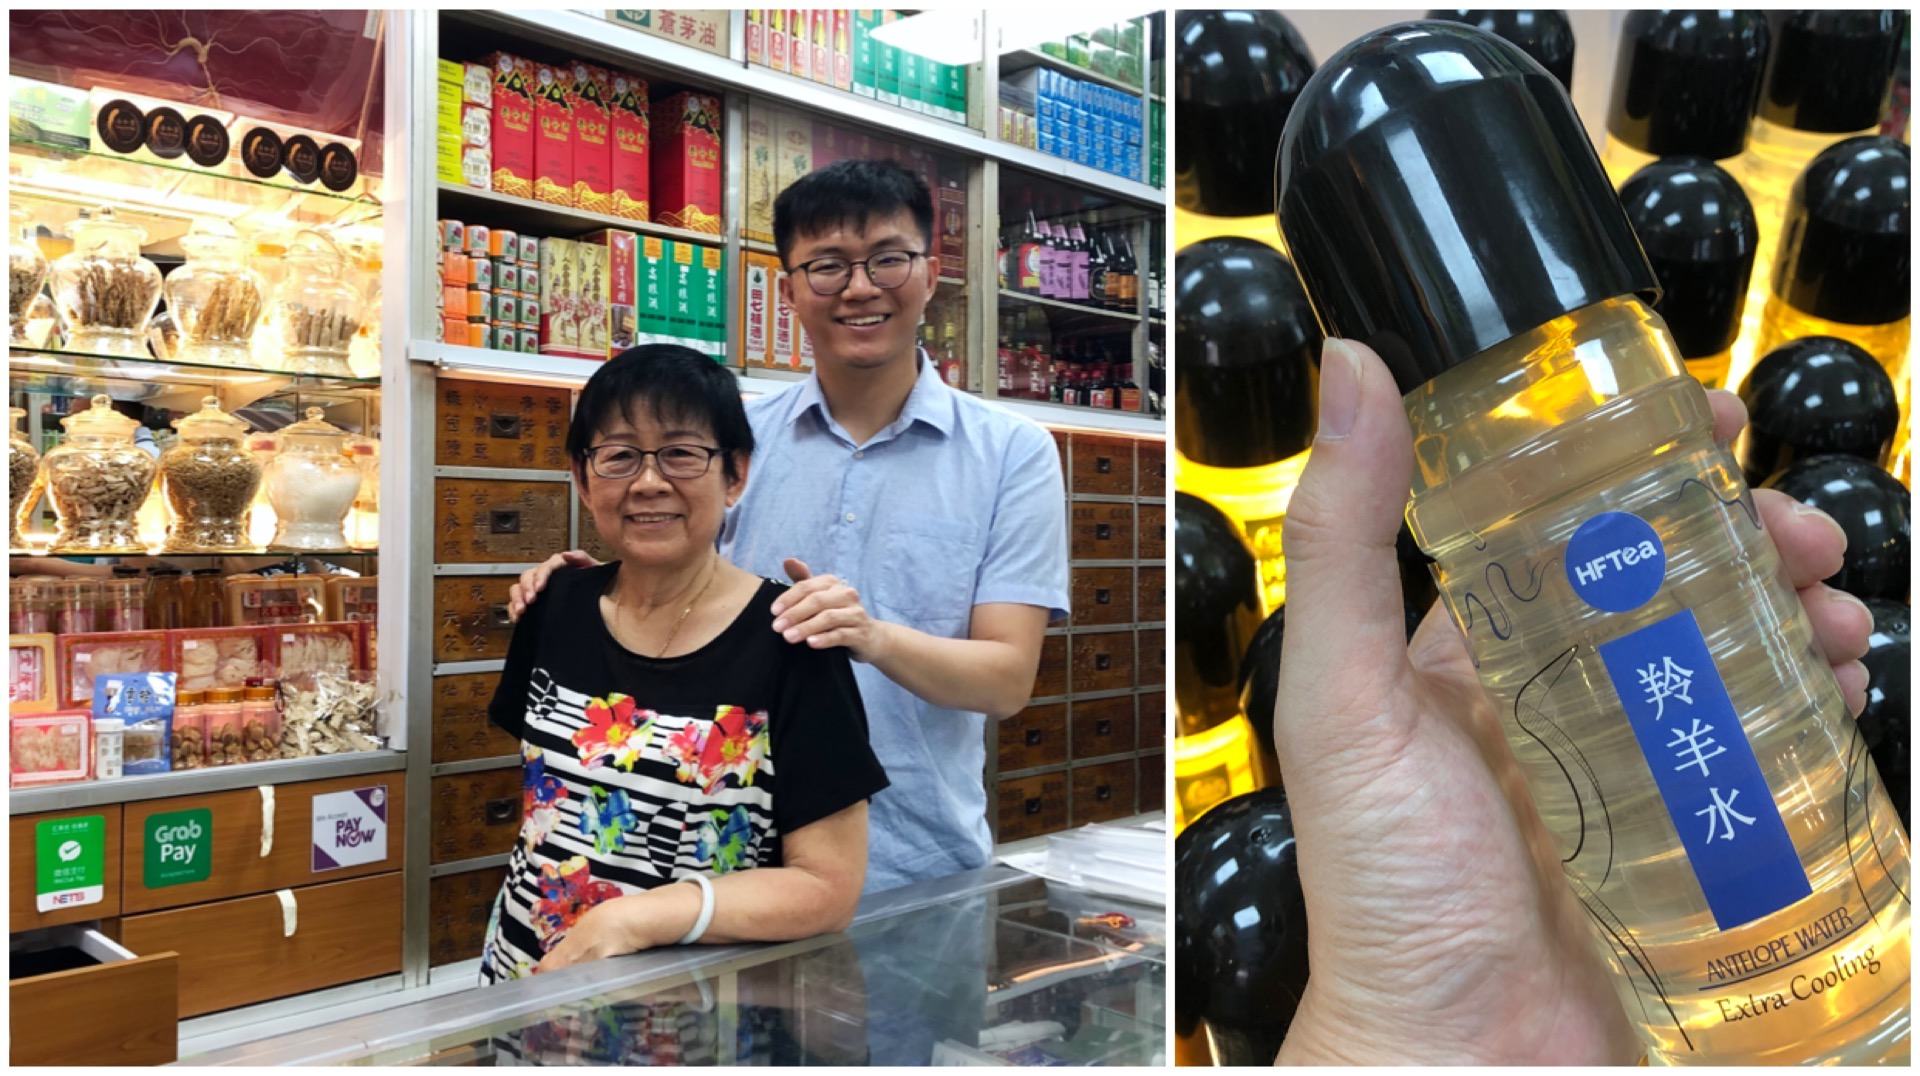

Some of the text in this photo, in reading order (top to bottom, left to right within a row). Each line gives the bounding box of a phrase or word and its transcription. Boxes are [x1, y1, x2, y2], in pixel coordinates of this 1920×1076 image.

[1636, 656, 1757, 844] 羚羊水
[155, 819, 203, 843] Grab
[336, 816, 362, 833] PAY
[336, 828, 376, 848] NOW
[160, 843, 197, 865] Pay
[1707, 906, 1853, 982] ANTELOPE WATER
[1716, 945, 1881, 1023] Extra Cooling
